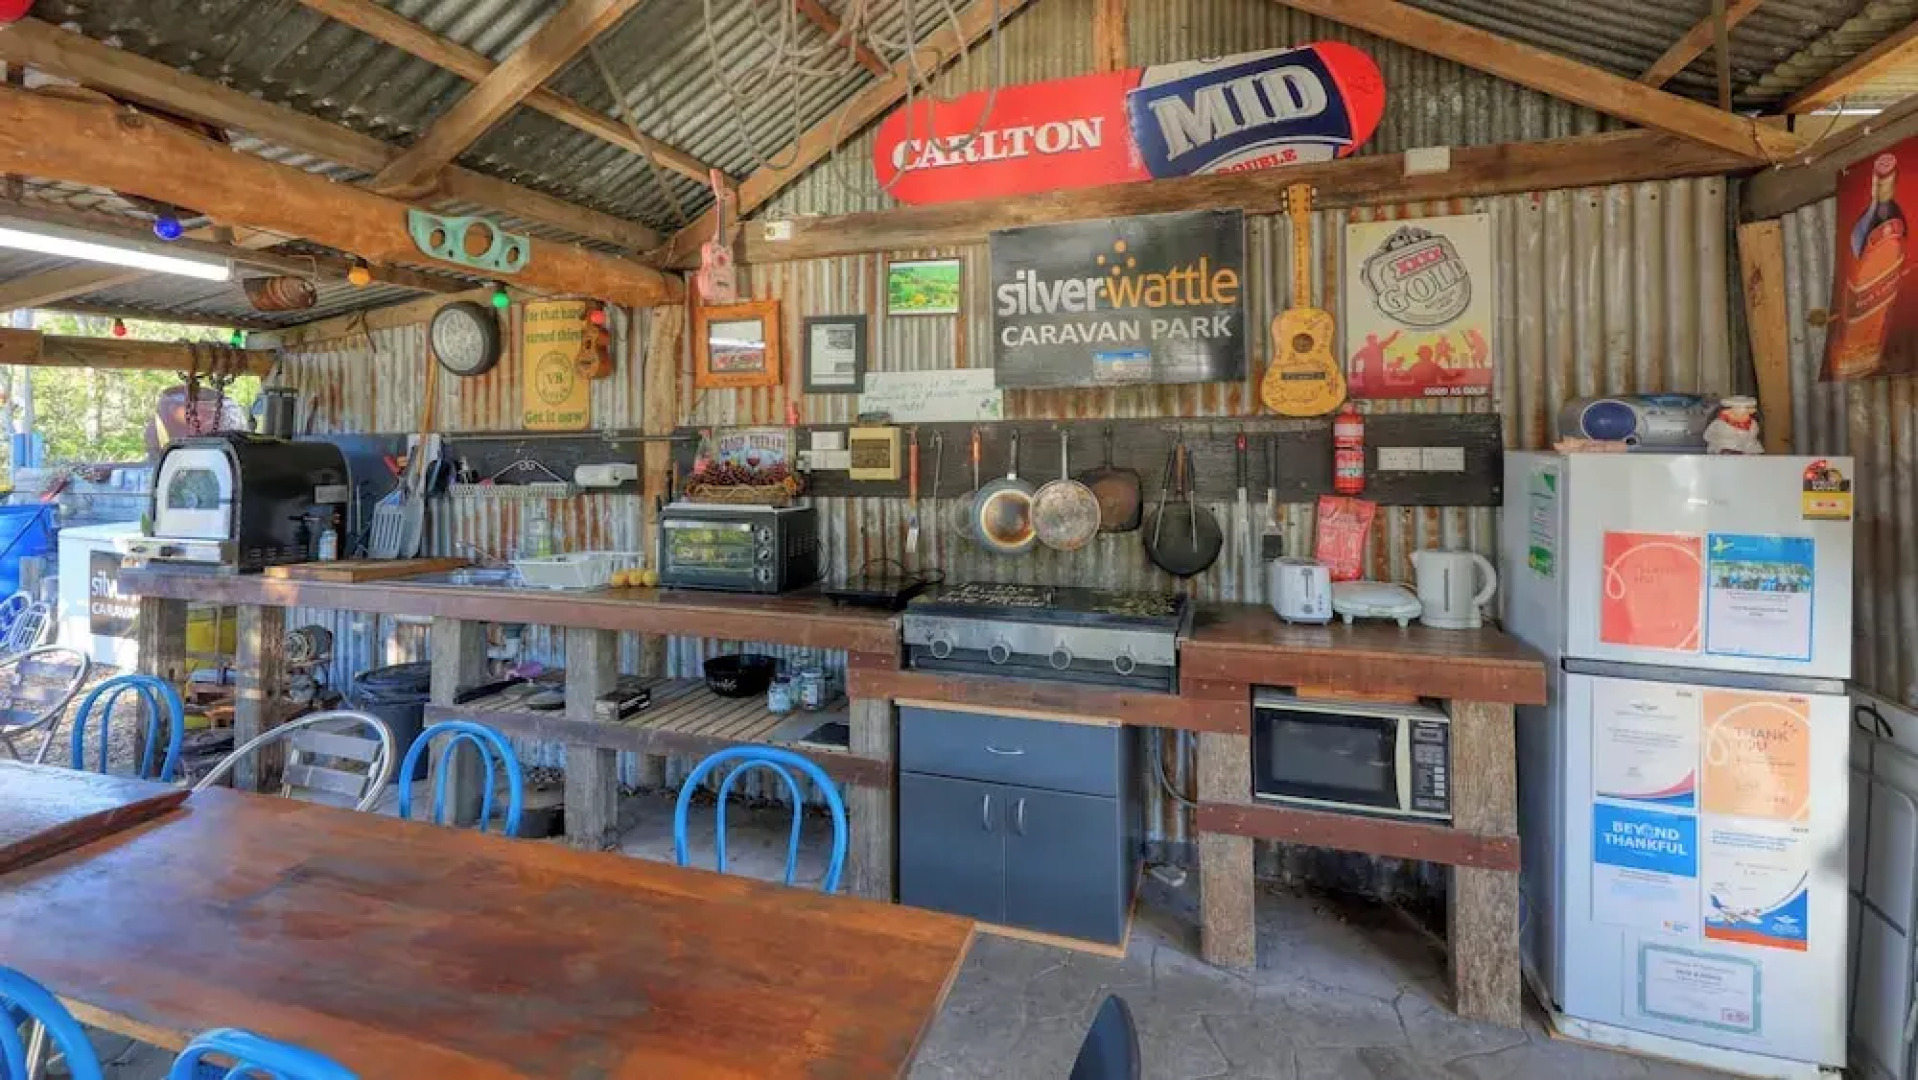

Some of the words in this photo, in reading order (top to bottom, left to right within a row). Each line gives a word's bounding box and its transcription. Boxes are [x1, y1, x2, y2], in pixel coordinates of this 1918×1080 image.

[1147, 64, 1328, 162] MID
[892, 116, 1105, 171] CARLTON
[997, 268, 1104, 317] silver
[1106, 256, 1239, 309] wattle
[1001, 318, 1141, 348] CARAVAN
[1150, 314, 1233, 341] PARK
[1735, 726, 1789, 743] THANK
[1604, 831, 1689, 857] THANKFUL
[1612, 820, 1679, 841] BEYOND
